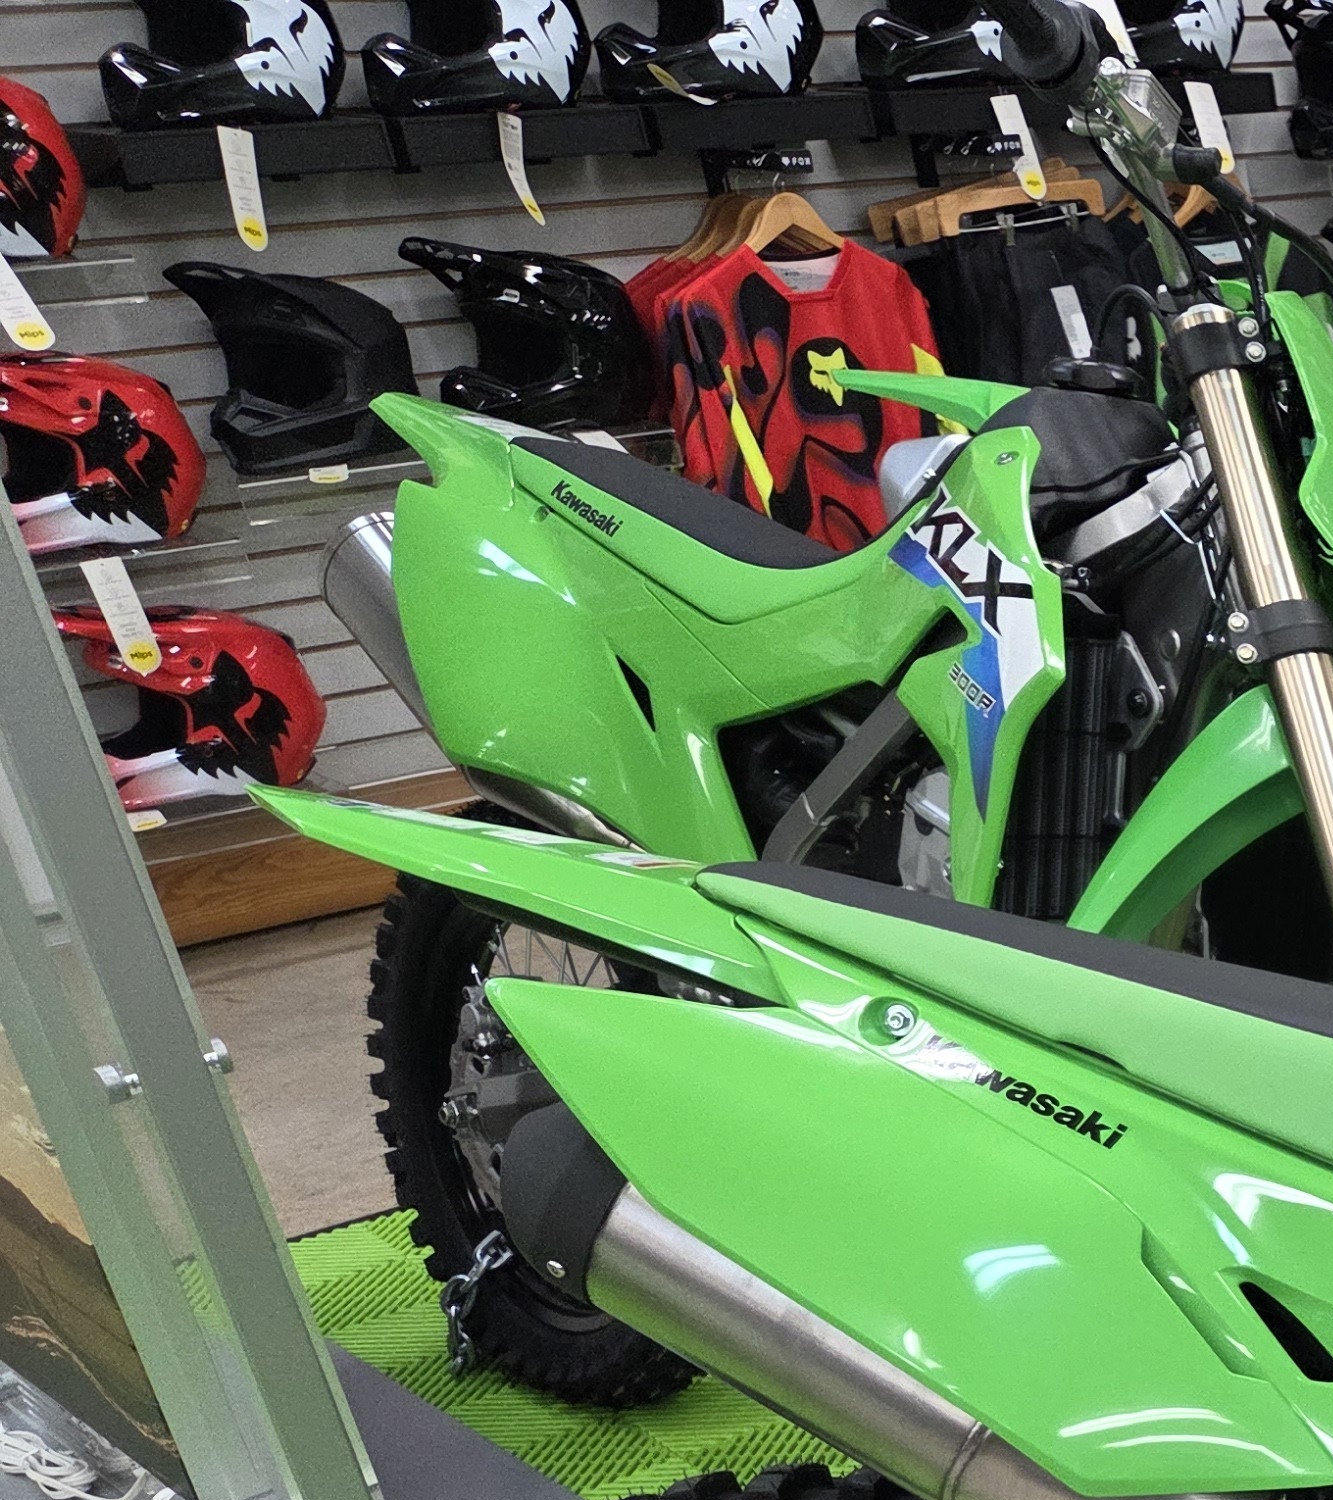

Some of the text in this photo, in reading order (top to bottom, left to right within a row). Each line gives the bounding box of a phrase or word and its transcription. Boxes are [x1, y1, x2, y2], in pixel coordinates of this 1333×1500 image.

[550, 479, 624, 538] Kawasaki
[910, 485, 1034, 637] KLX
[948, 661, 997, 713] 300R
